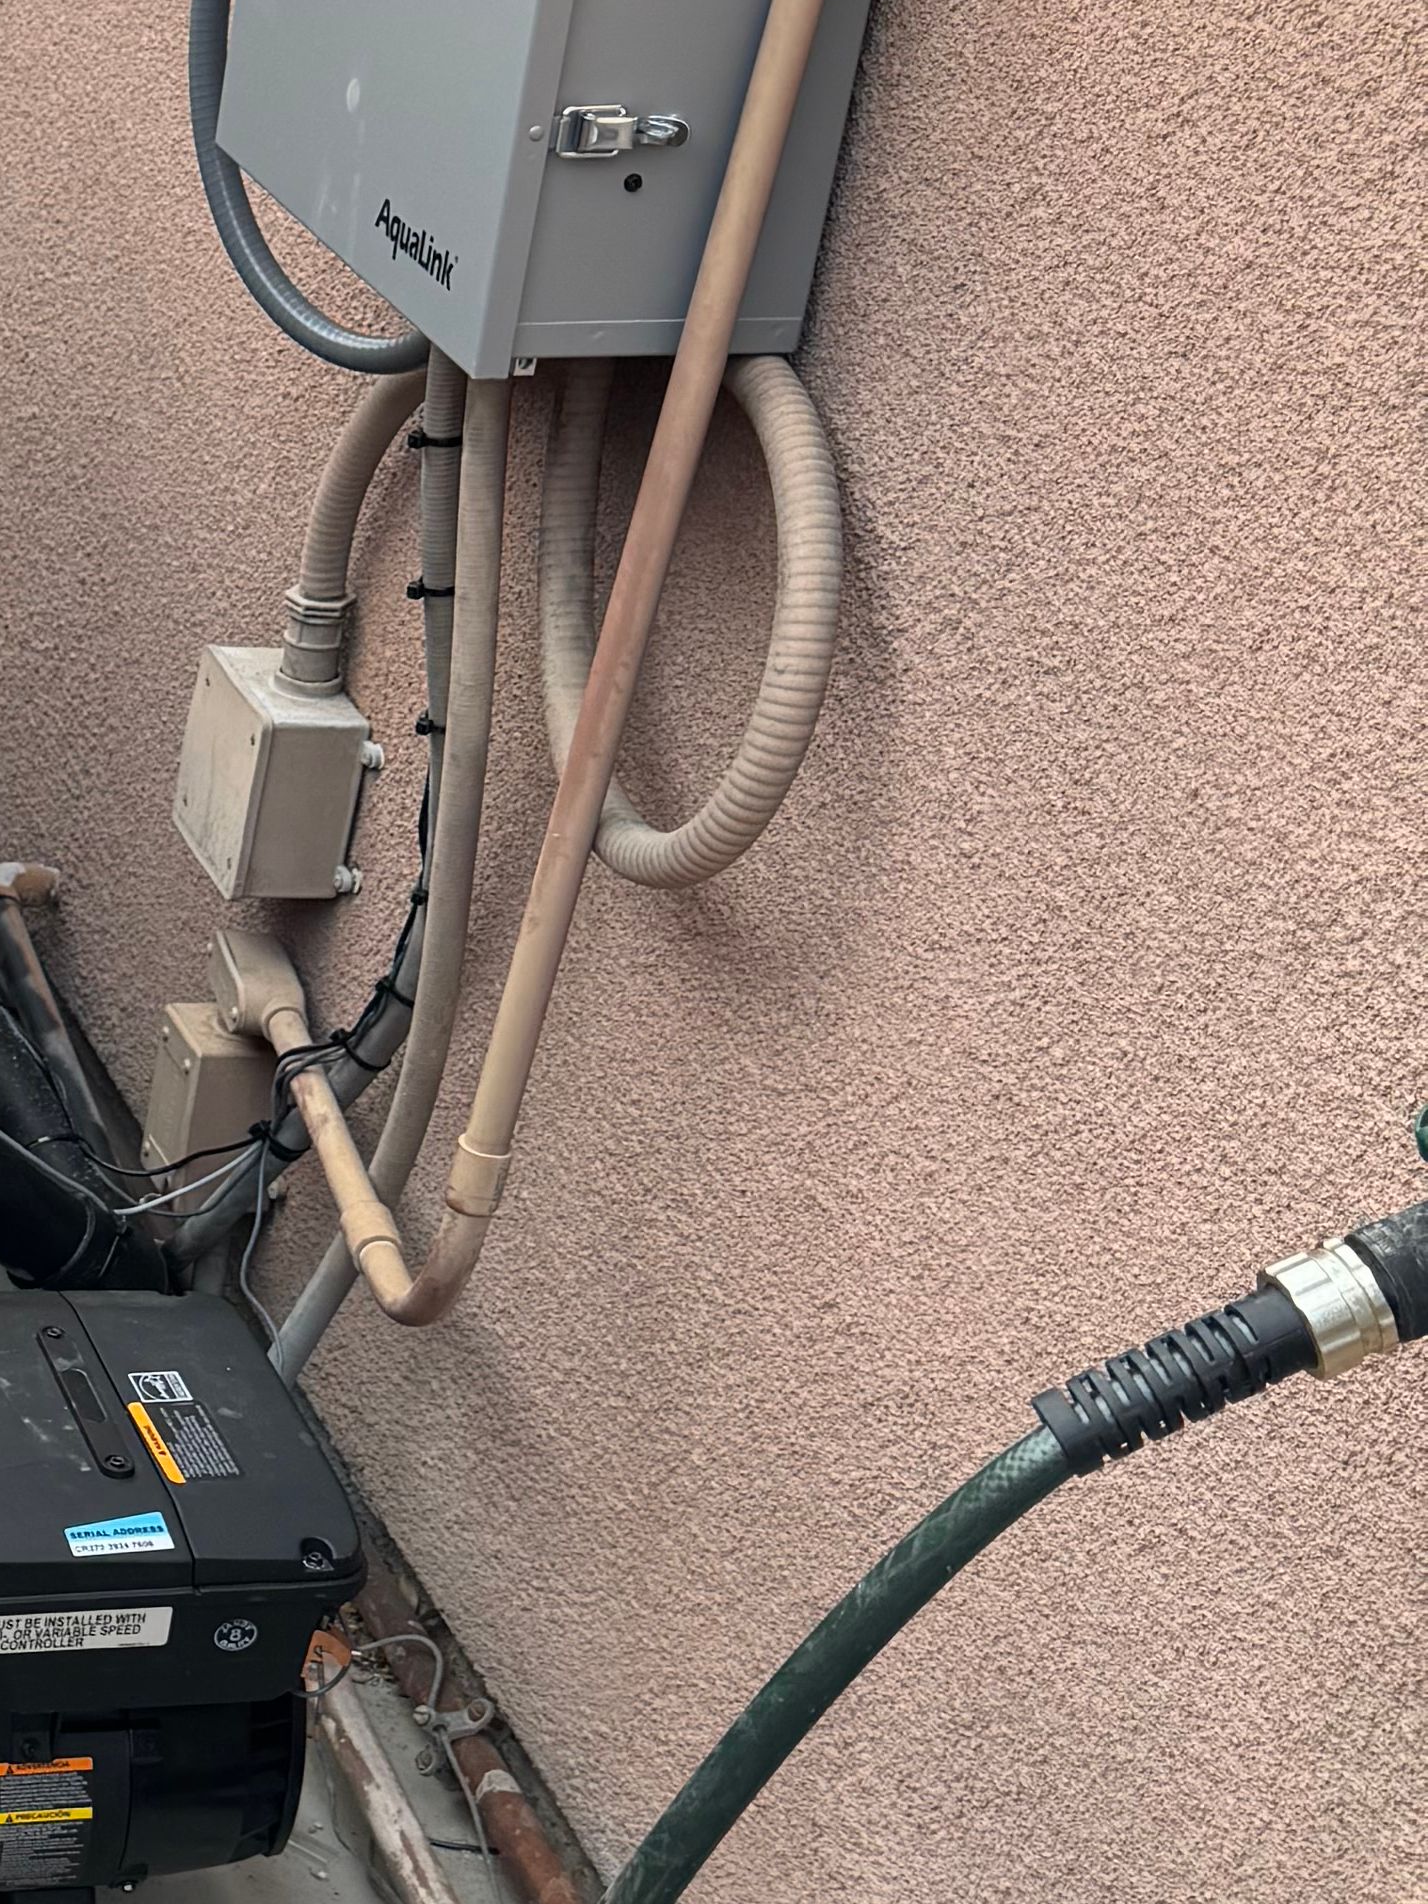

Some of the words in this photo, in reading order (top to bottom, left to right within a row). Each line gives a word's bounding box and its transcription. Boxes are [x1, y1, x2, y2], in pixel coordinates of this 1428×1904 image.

[374, 198, 454, 292] AquaLink
[70, 1529, 111, 1539] SERIAL
[113, 1525, 164, 1536] ADDRESS
[24, 1618, 42, 1629] BE
[44, 1614, 112, 1627] INSTALLED
[116, 1613, 147, 1624] WITH
[13, 1629, 32, 1640] OR
[34, 1626, 97, 1638] VARIABLE
[99, 1624, 141, 1636] SPEED
[230, 1628, 242, 1641] 8
[0, 1637, 85, 1651] CONTROLLER
